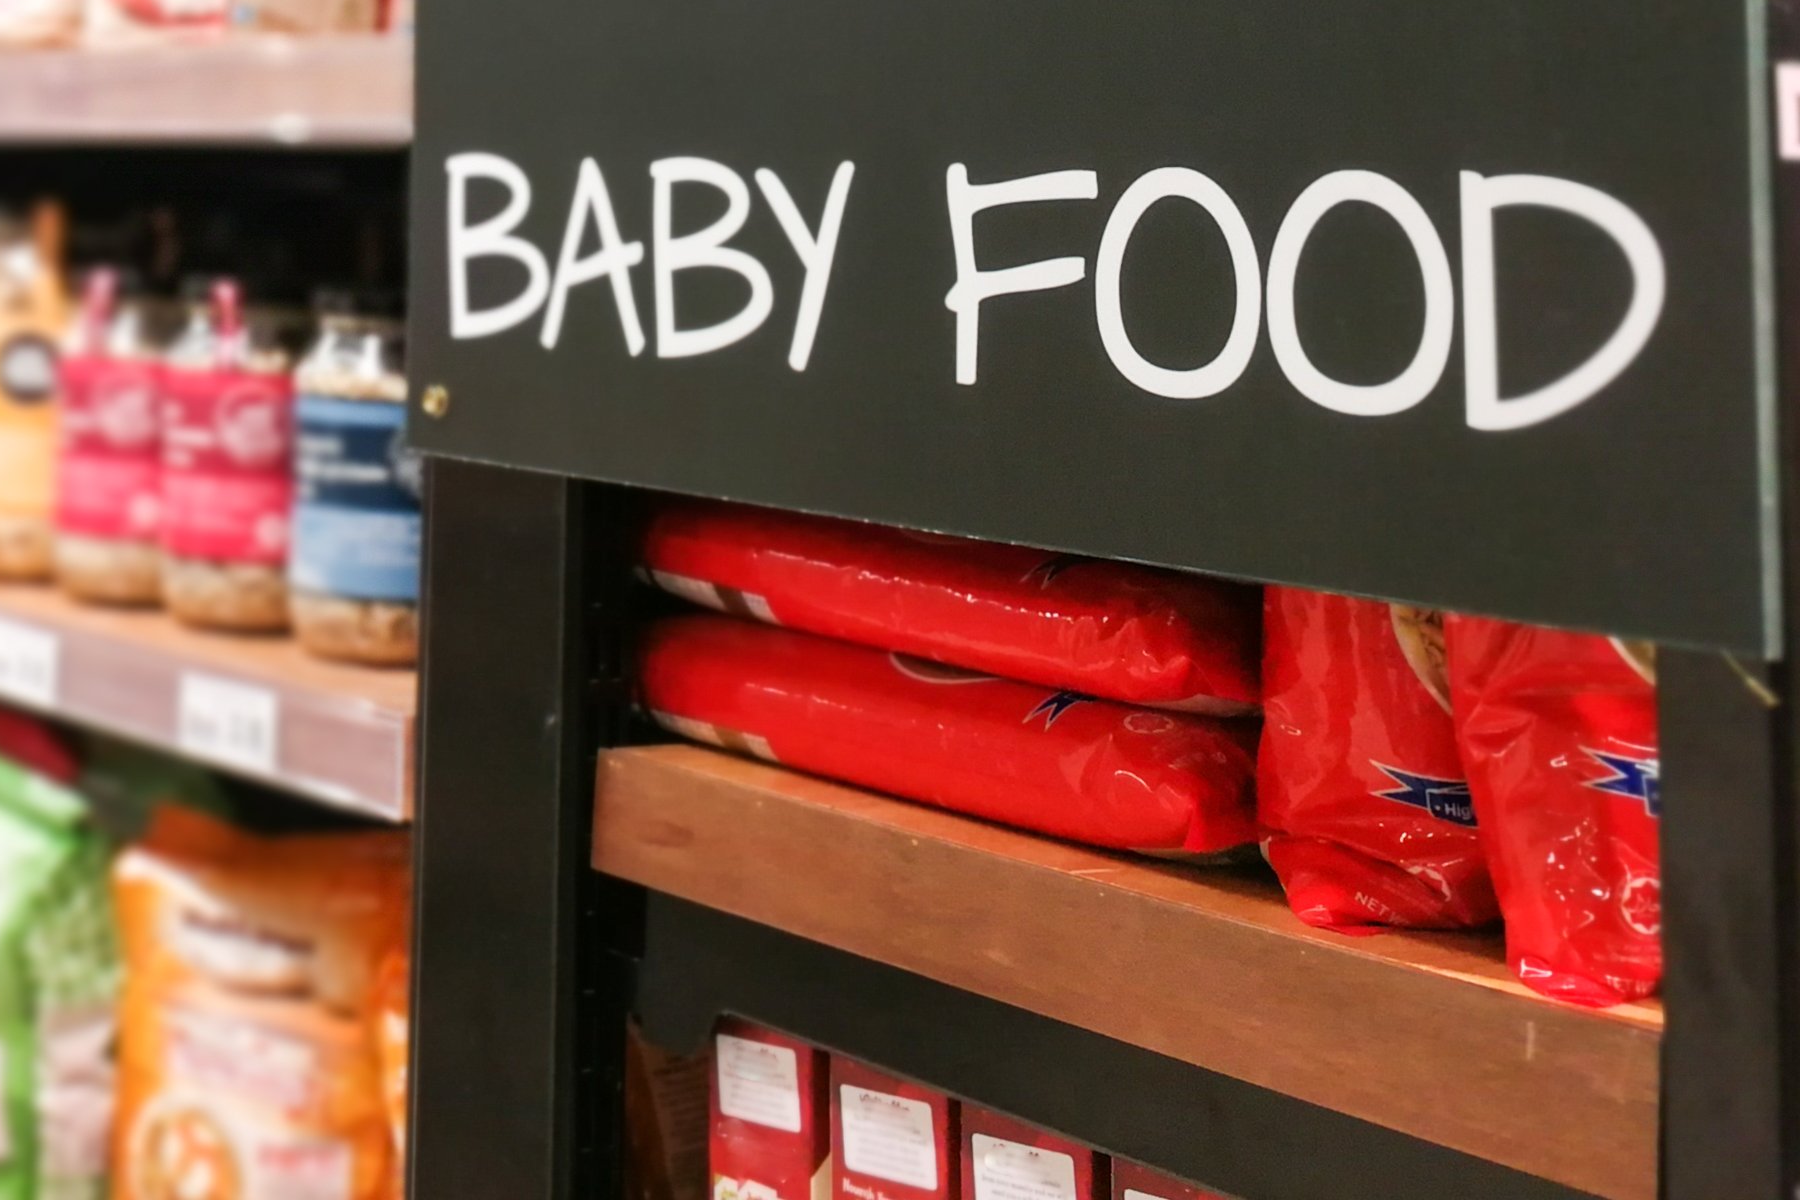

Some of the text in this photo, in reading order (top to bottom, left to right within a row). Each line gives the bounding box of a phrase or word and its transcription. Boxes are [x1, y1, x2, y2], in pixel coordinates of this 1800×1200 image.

[445, 152, 1665, 431] BABY FOOD
[1444, 803, 1473, 821] Hig
[1354, 891, 1391, 917] NET
